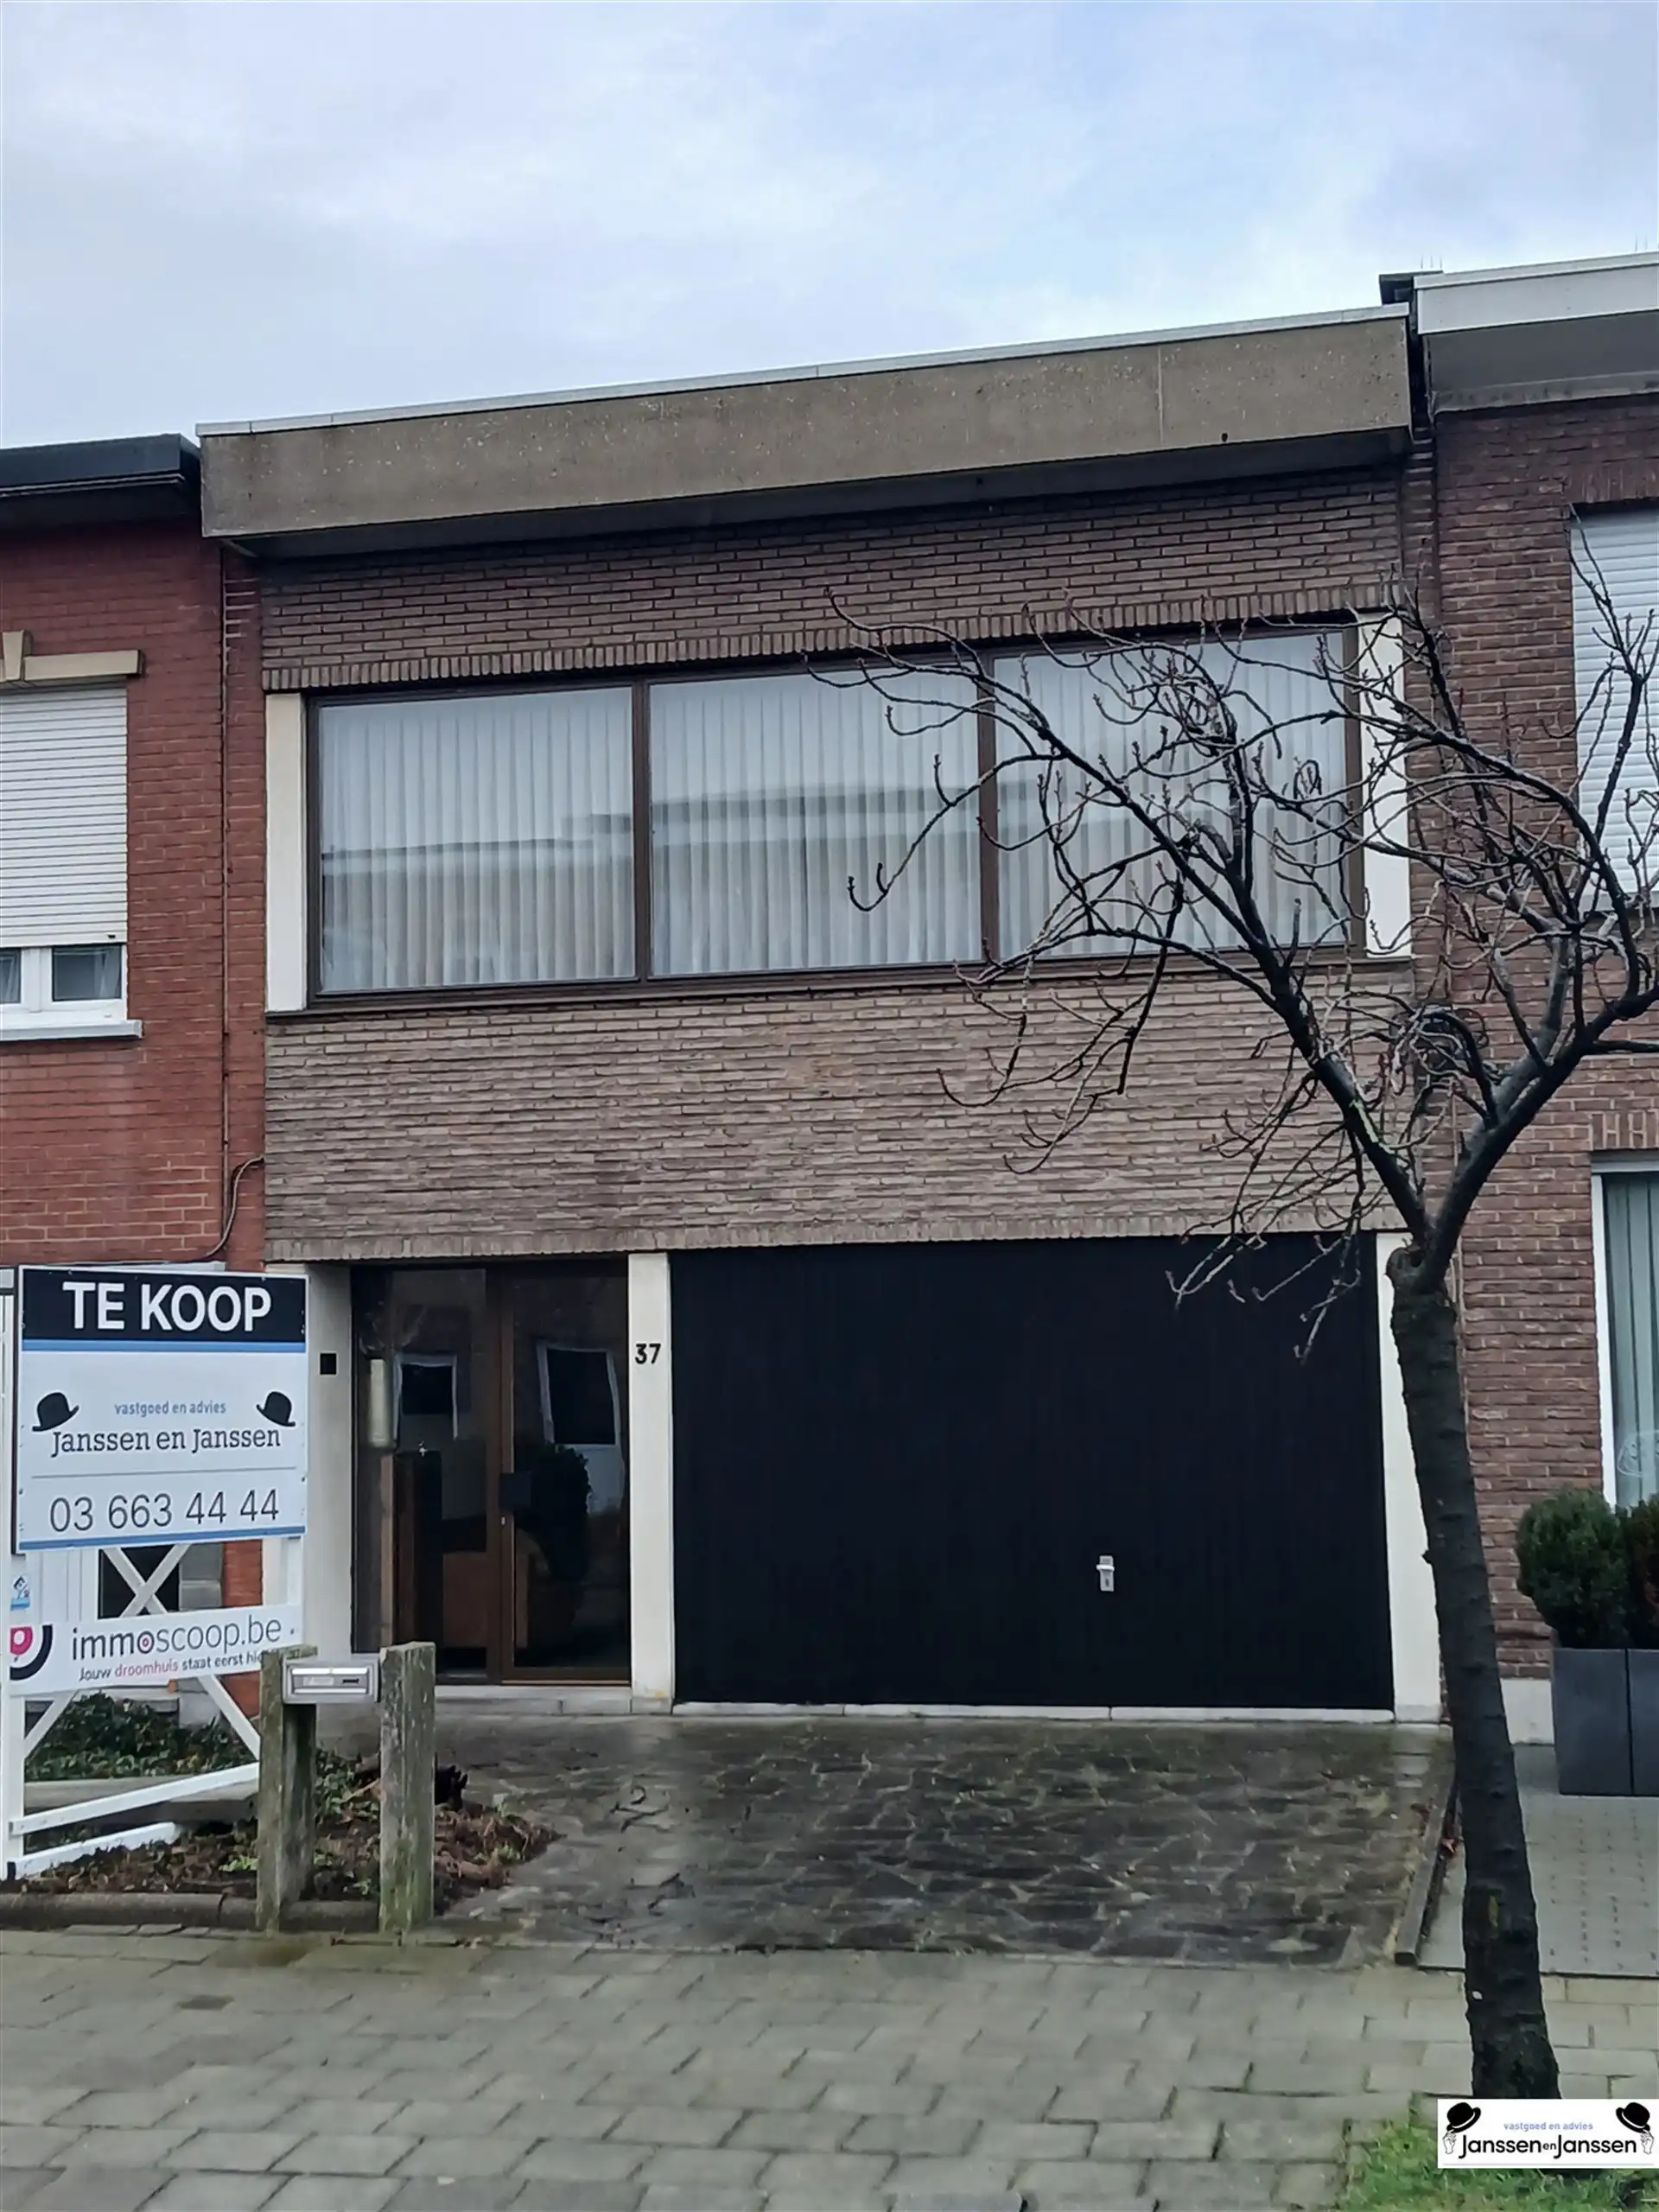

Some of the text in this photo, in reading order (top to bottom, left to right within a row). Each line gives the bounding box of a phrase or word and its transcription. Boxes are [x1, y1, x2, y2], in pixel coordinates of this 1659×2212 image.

[62, 1281, 271, 1332] TE KOOP
[635, 1343, 662, 1364] 37
[114, 1401, 226, 1418] vastgoed en advies
[50, 1428, 282, 1458] Janssen en Janssen
[49, 1489, 279, 1532] 03 663 44 44
[72, 1614, 283, 1661] immoscoop.be
[79, 1667, 112, 1681] Jouw
[115, 1659, 179, 1678] droomhuis
[181, 1656, 212, 1671] staat
[214, 1654, 245, 1667] eerst
